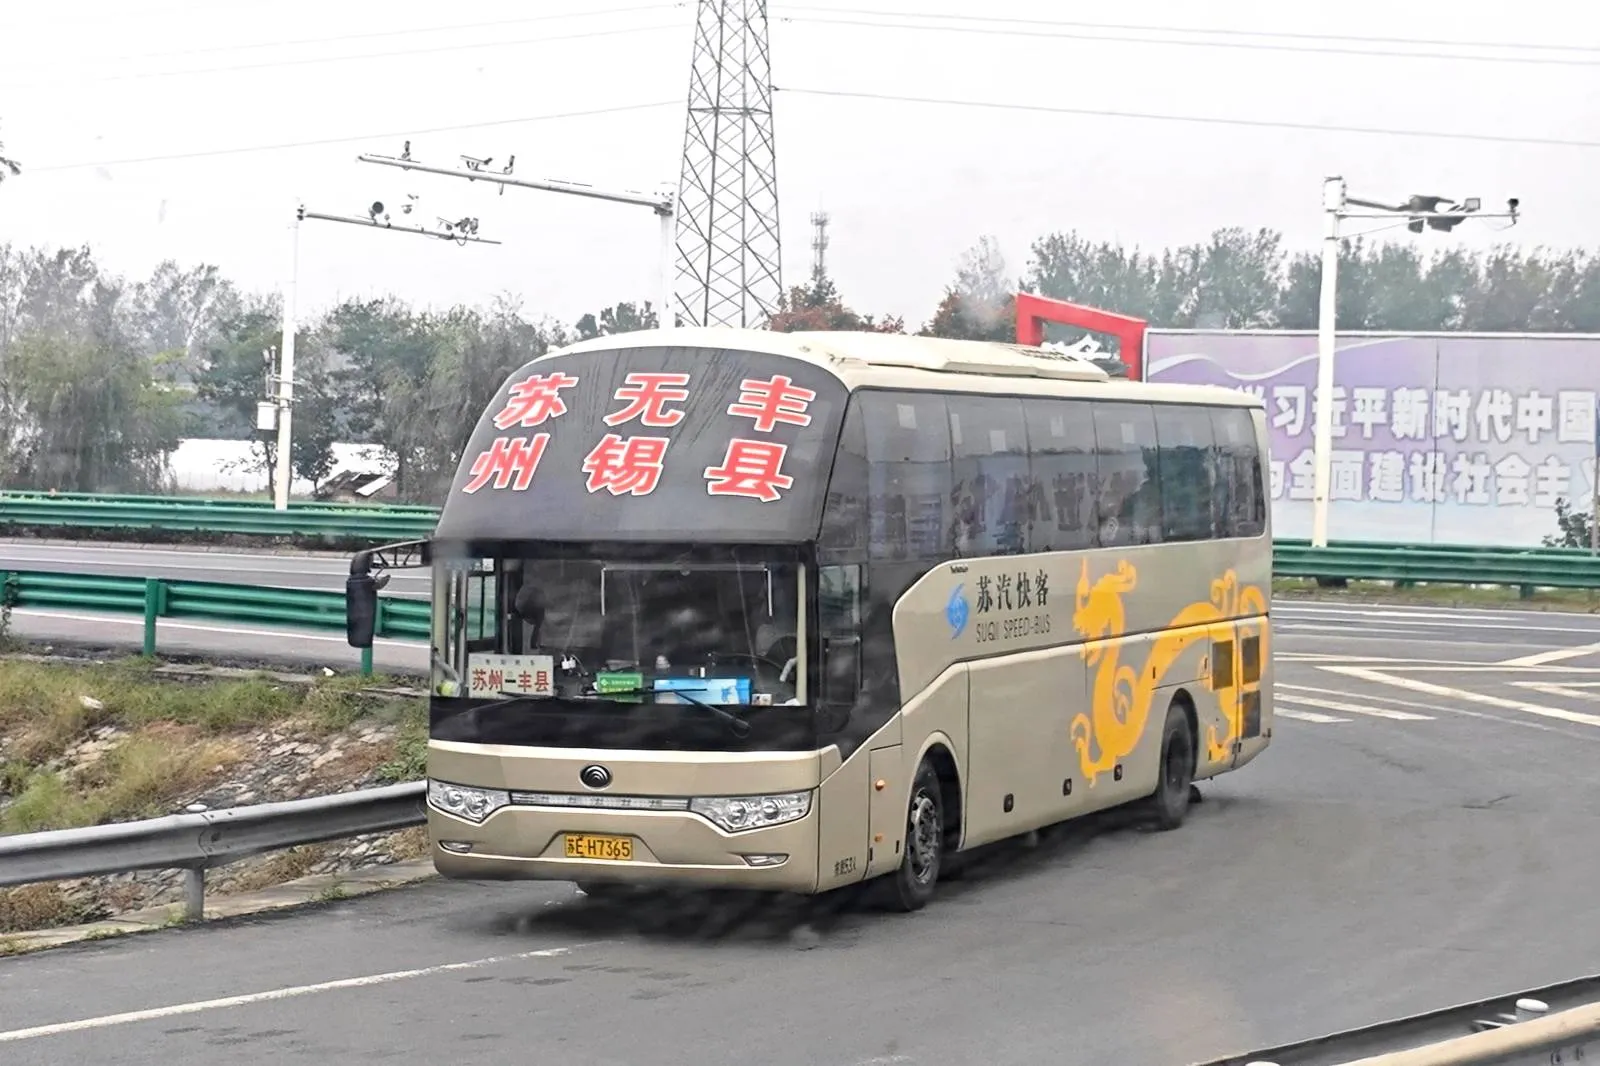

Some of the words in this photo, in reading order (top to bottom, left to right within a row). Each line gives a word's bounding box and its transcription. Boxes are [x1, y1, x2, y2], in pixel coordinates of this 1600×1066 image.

[1236, 384, 1596, 444] 习近平新时代中国
[976, 569, 1049, 614] 苏汽快客
[1003, 614, 1051, 640] SPEED-BUS
